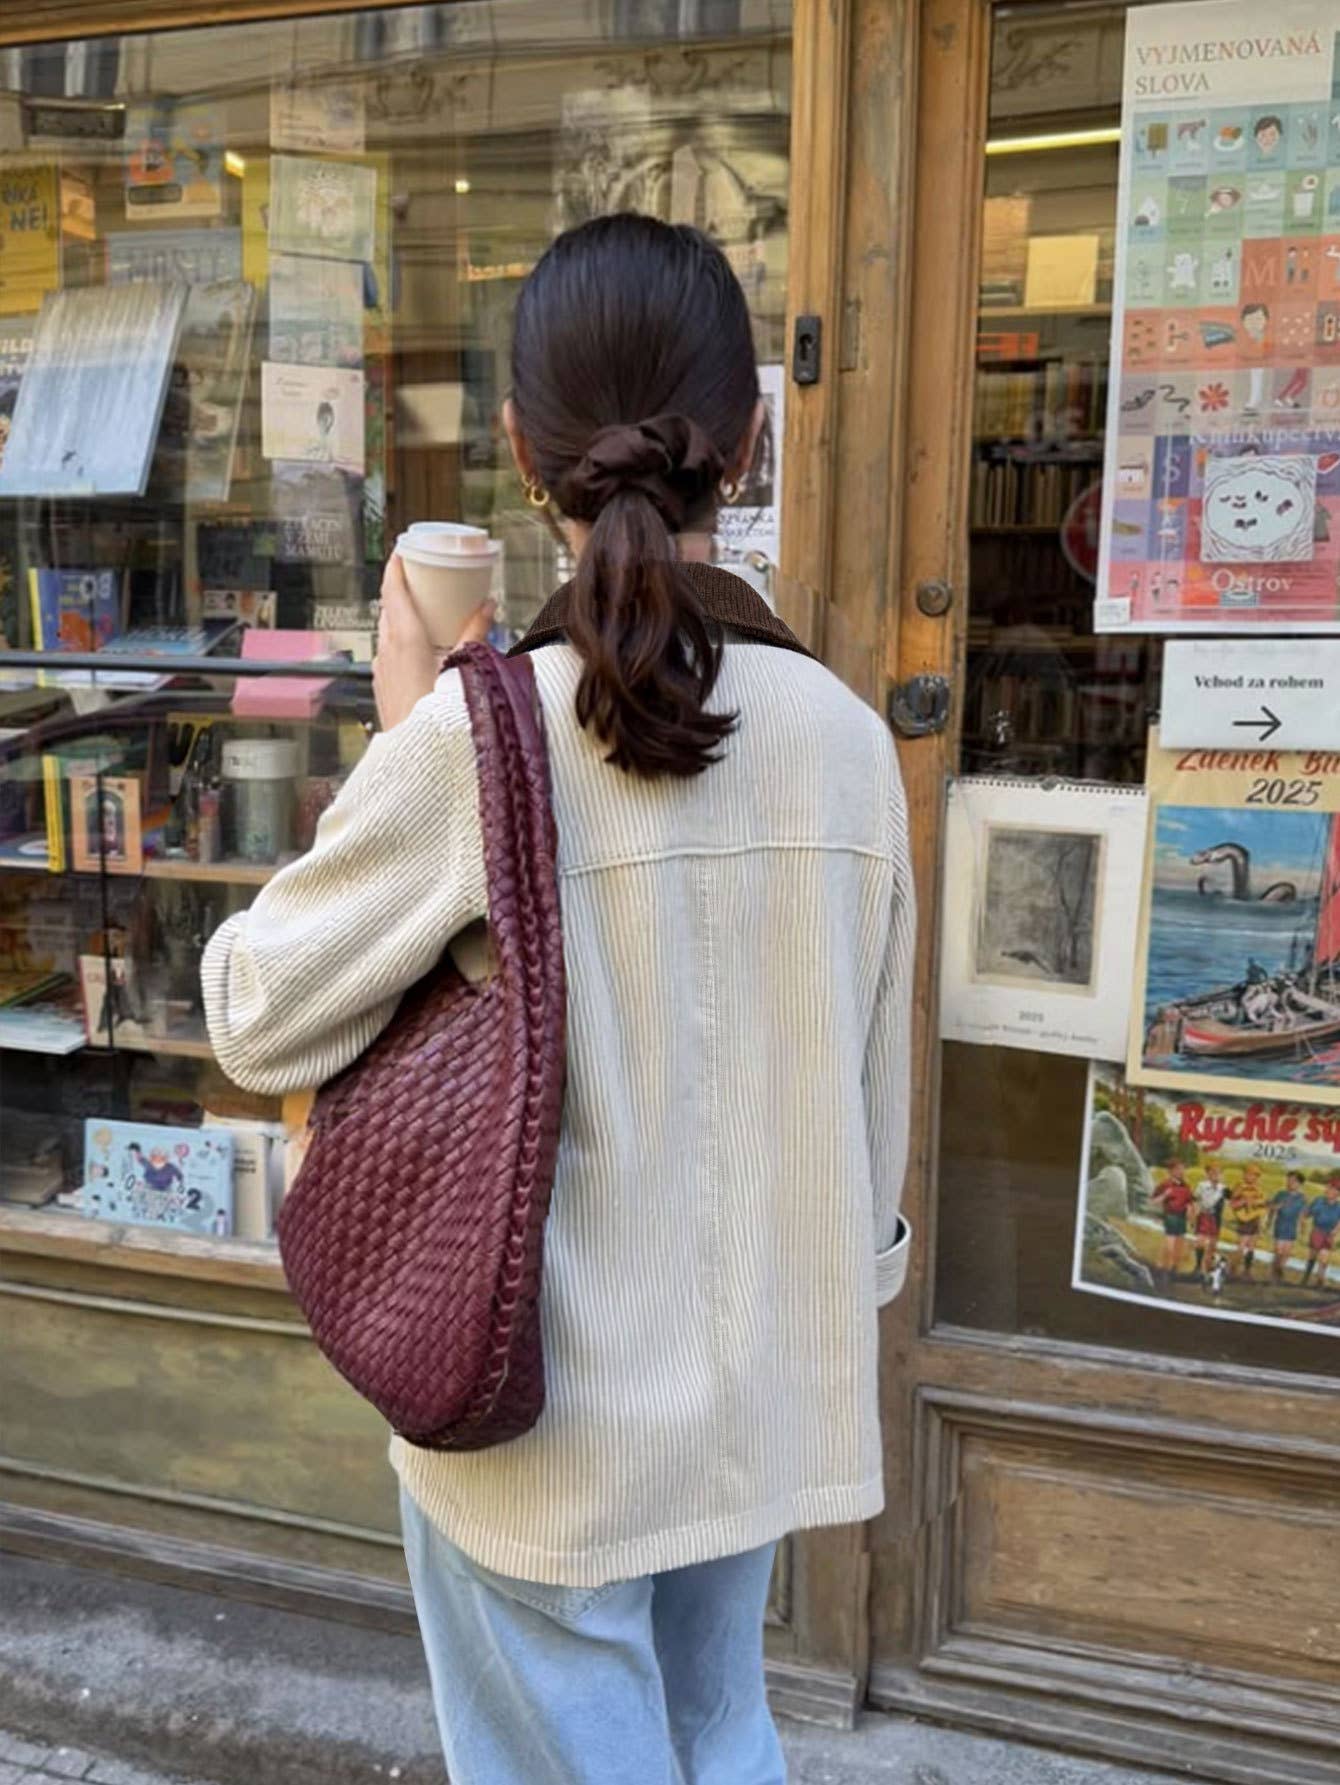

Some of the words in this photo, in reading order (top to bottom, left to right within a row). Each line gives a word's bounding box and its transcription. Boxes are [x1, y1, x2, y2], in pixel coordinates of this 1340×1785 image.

[1136, 31, 1321, 65] VYJMENOVANÁ
[1135, 73, 1210, 96] SLOVA
[1244, 256, 1277, 287] M
[1211, 568, 1293, 592] Ostrov
[1194, 675, 1243, 689] Vchod
[1247, 678, 1265, 689] za
[1269, 675, 1324, 689] rohem
[1245, 778, 1323, 806] 2025
[1253, 1143, 1297, 1160] 2025
[186, 1187, 202, 1210] 2
